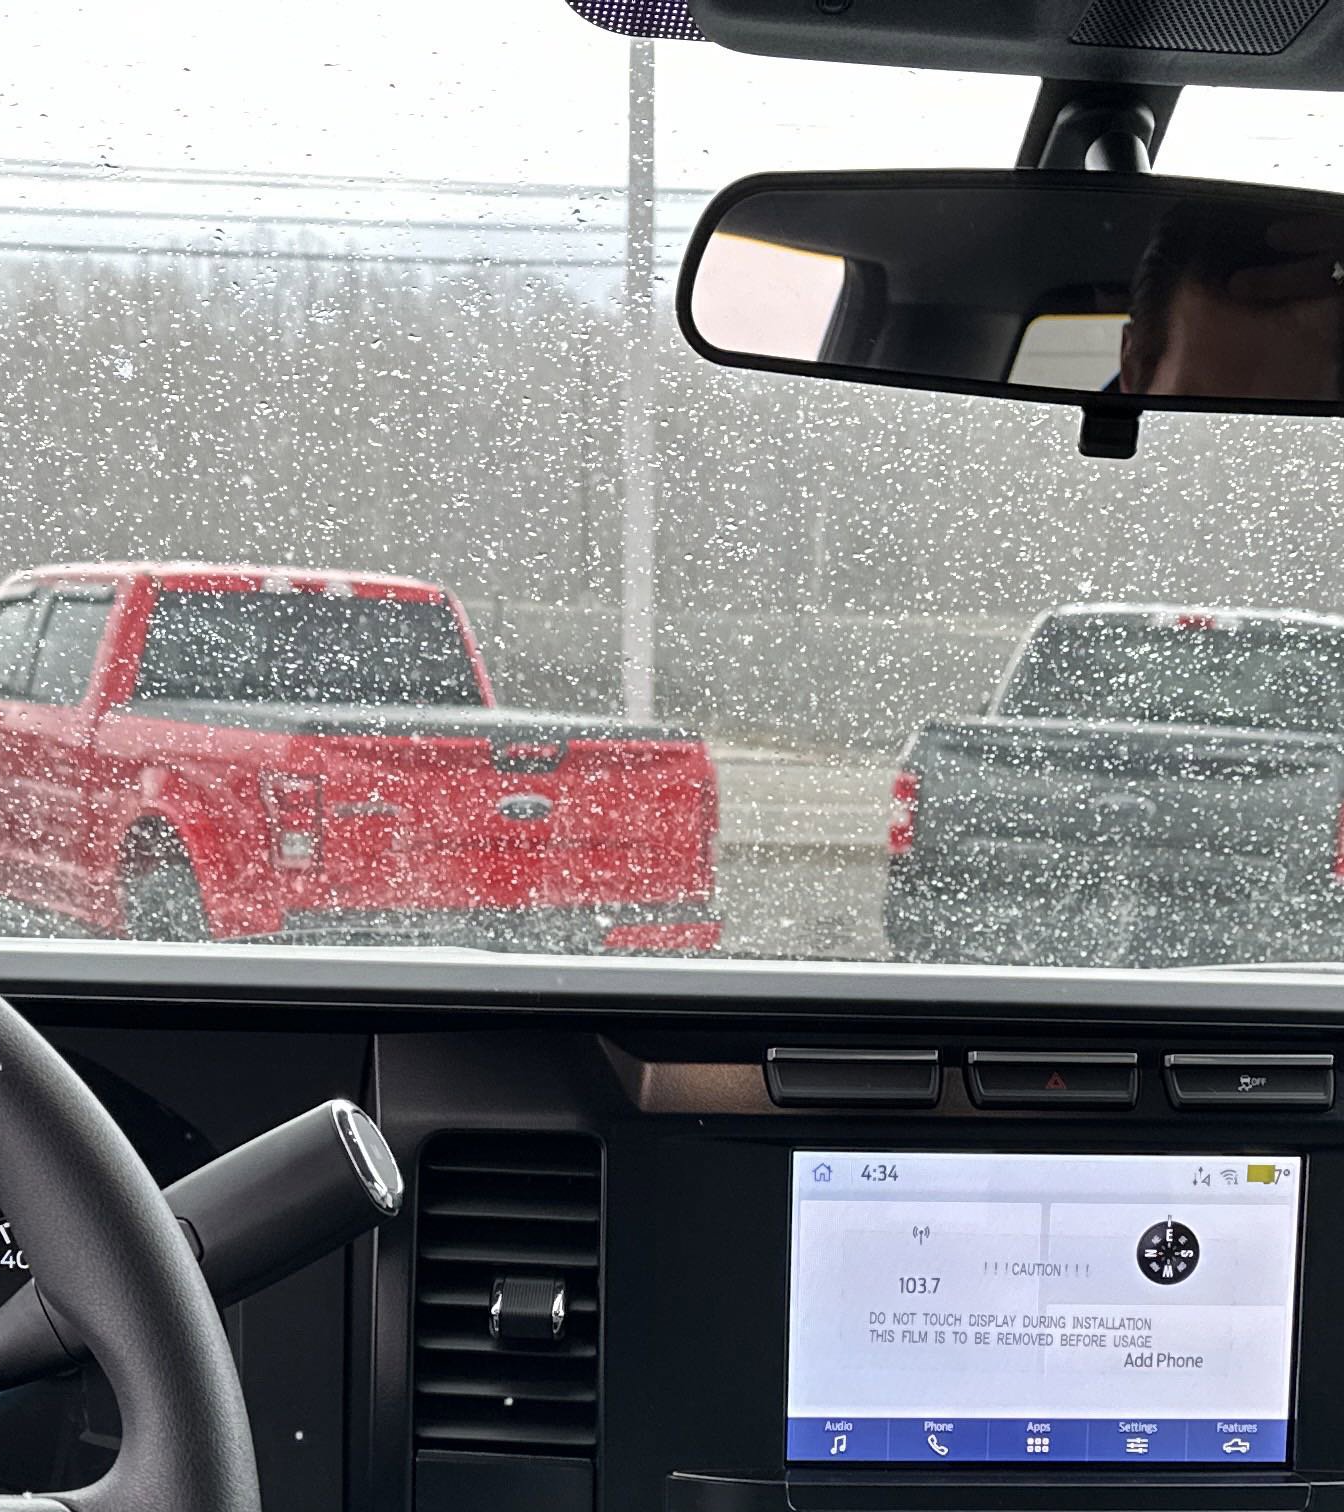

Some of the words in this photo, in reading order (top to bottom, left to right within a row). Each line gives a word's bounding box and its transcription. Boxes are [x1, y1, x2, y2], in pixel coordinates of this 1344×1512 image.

[861, 1164, 898, 1182] 4:34
[1166, 1229, 1173, 1242] E
[1012, 1263, 1061, 1276] CAUTION
[899, 1277, 941, 1294] 103.7
[869, 1312, 886, 1325] DO
[893, 1312, 917, 1325] NOT
[923, 1313, 962, 1326] TOUCH
[969, 1314, 1016, 1328] DISPLAY
[1022, 1315, 1066, 1329] DURING
[1072, 1316, 1152, 1331] INSTALLATION
[869, 1329, 895, 1343] THIS
[902, 1330, 928, 1343] FILM
[934, 1331, 946, 1344] IS
[952, 1331, 968, 1345] TO
[974, 1332, 991, 1345] BE
[997, 1333, 1054, 1346] REMOVED
[1060, 1334, 1107, 1347] BEFORE
[1113, 1335, 1153, 1348] USAGE
[1124, 1352, 1154, 1368] Add
[1157, 1352, 1204, 1368] Phone
[825, 1421, 853, 1431] Audio
[924, 1421, 954, 1432] Phone
[1026, 1422, 1051, 1433] Apps
[1119, 1422, 1158, 1434] Settings
[1217, 1422, 1258, 1433] Features
